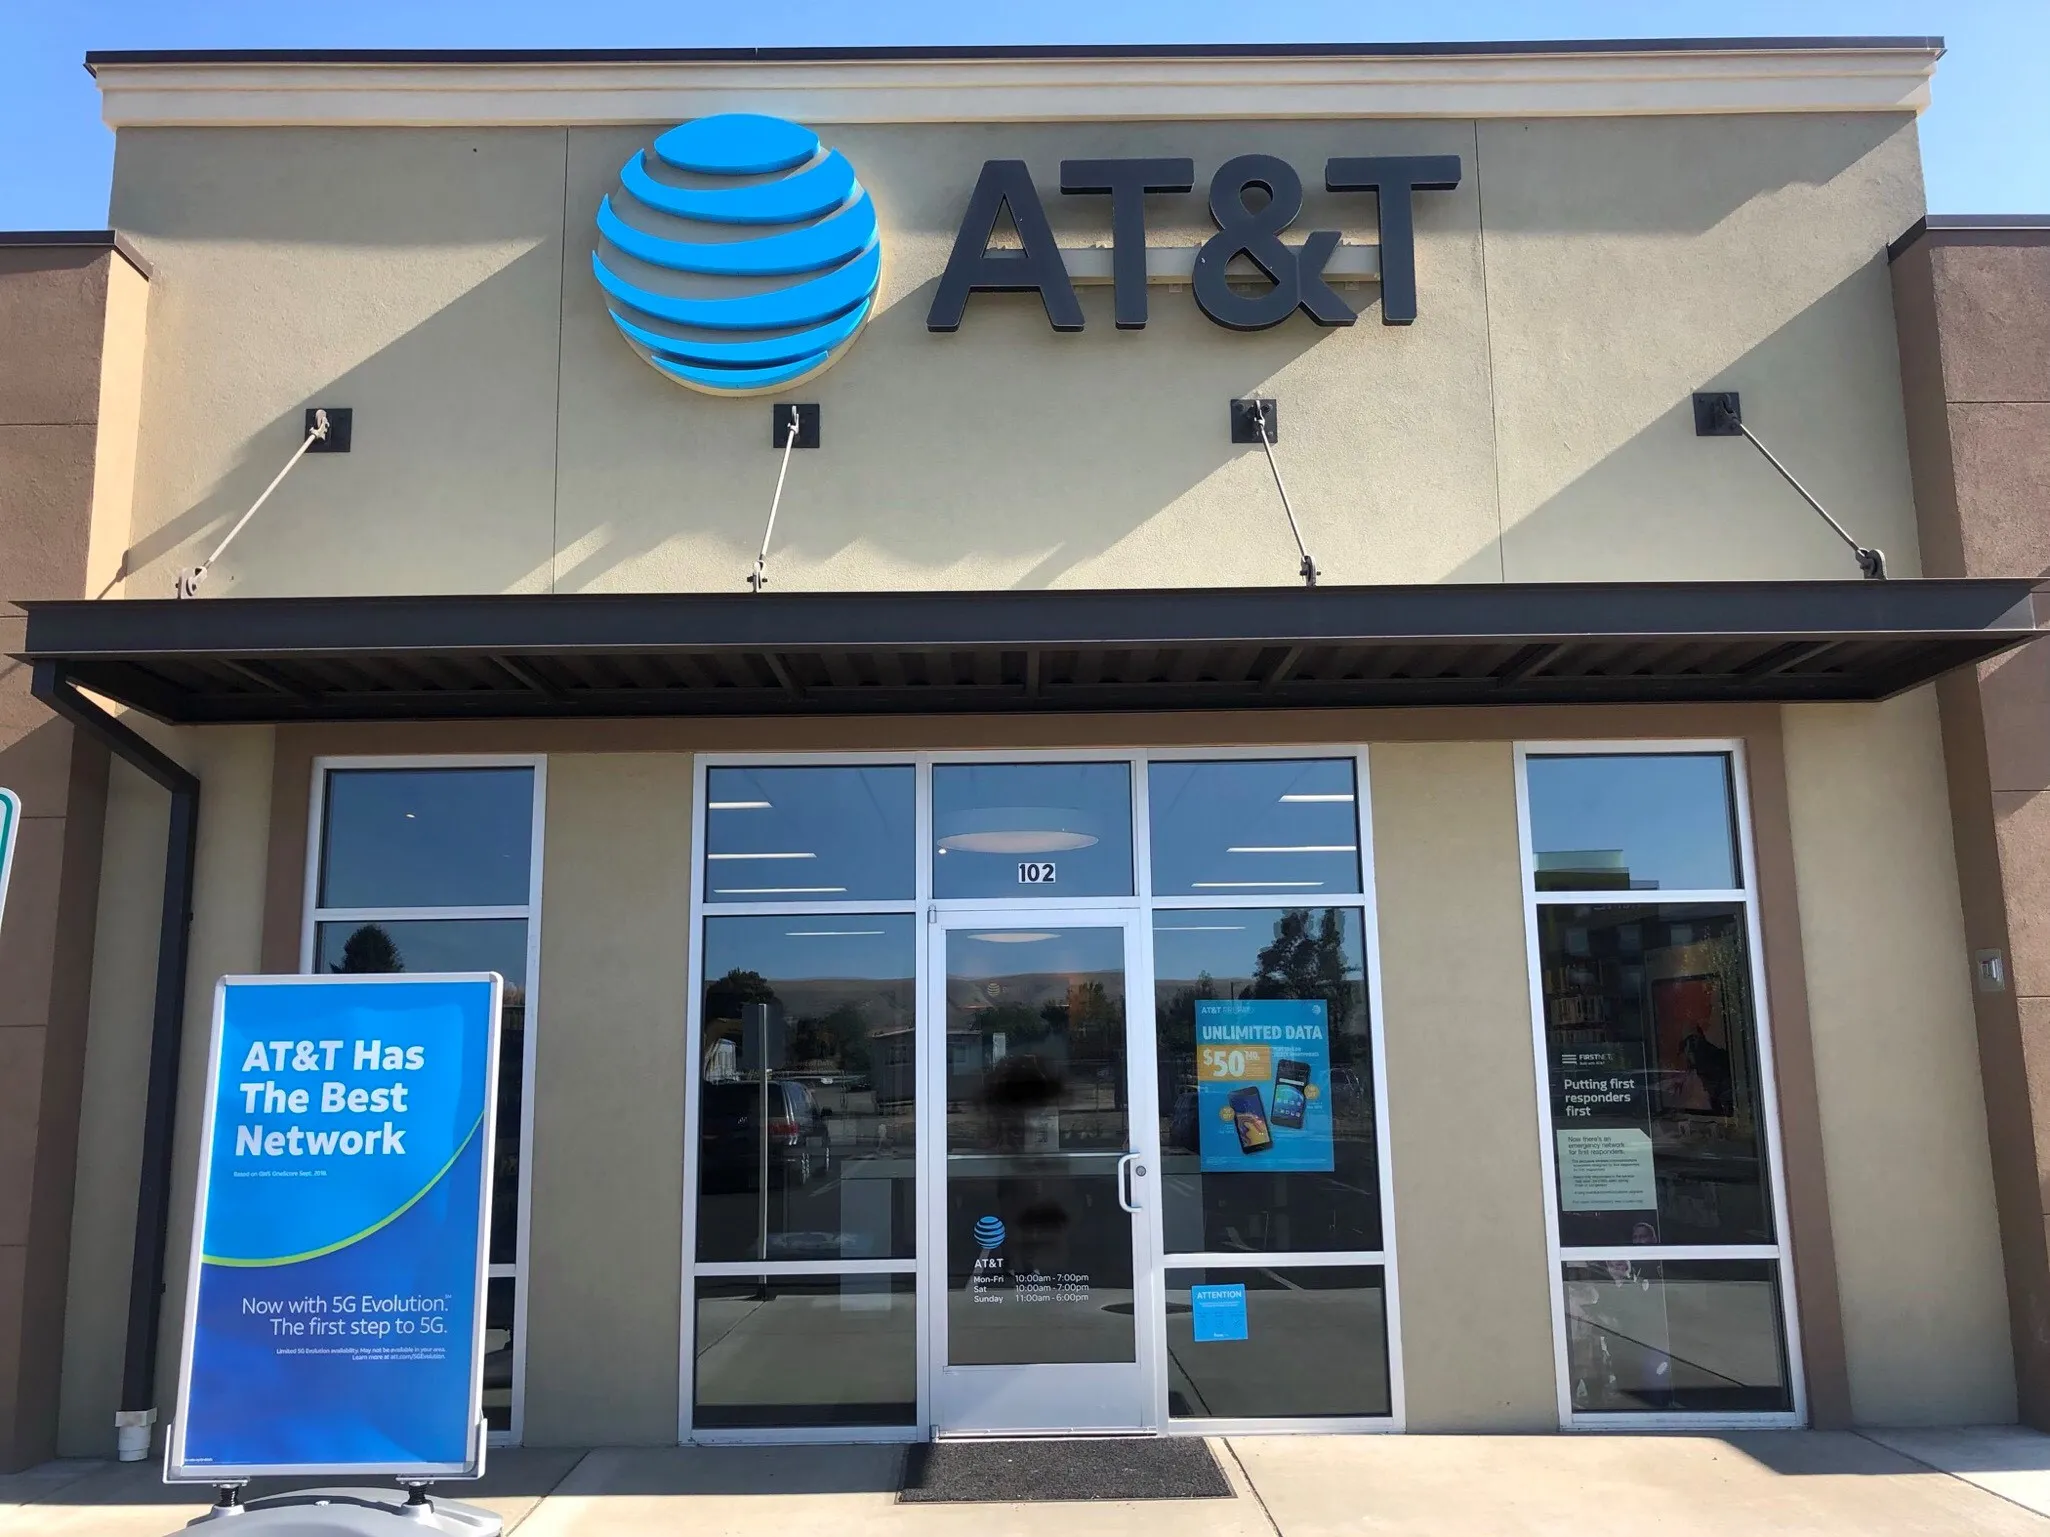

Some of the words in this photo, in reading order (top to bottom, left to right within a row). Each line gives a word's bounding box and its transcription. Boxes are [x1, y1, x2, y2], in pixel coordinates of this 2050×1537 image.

[927, 153, 1461, 333] AT&T
[1019, 863, 1054, 882] 102
[1201, 1006, 1221, 1014] AT&T
[1202, 1025, 1282, 1040] UNLIMITED
[1285, 1025, 1323, 1040] DATA
[241, 1039, 344, 1072] AT&T
[353, 1039, 425, 1071] Has
[1203, 1048, 1245, 1077] $50
[1564, 1079, 1607, 1091] Putting
[1610, 1078, 1635, 1089] first
[239, 1080, 310, 1114] The
[321, 1081, 408, 1113] Best
[1565, 1092, 1631, 1104] responders
[1566, 1105, 1591, 1117] first
[235, 1121, 407, 1157] Network
[974, 1258, 1004, 1268] AT&T
[973, 1275, 1004, 1283] Mon-Fri
[1015, 1274, 1051, 1283] 10:00am
[1057, 1274, 1089, 1283] 7:00pm
[973, 1285, 987, 1293] Sat
[1015, 1284, 1051, 1292] 10:00am
[1057, 1283, 1090, 1292] 7:00pm
[1197, 1290, 1242, 1300] ATTENTION
[242, 1298, 284, 1314] Now
[288, 1296, 327, 1313] with
[332, 1296, 356, 1313] 5G
[362, 1294, 449, 1313] Evolution.
[974, 1295, 1004, 1304] Sunday
[1016, 1294, 1050, 1302] 11:00am
[1056, 1293, 1089, 1303] 6:00pm
[270, 1318, 305, 1335] The
[309, 1317, 345, 1335] first
[350, 1318, 391, 1339] step
[395, 1318, 415, 1333] to
[419, 1316, 448, 1333] 5G.
